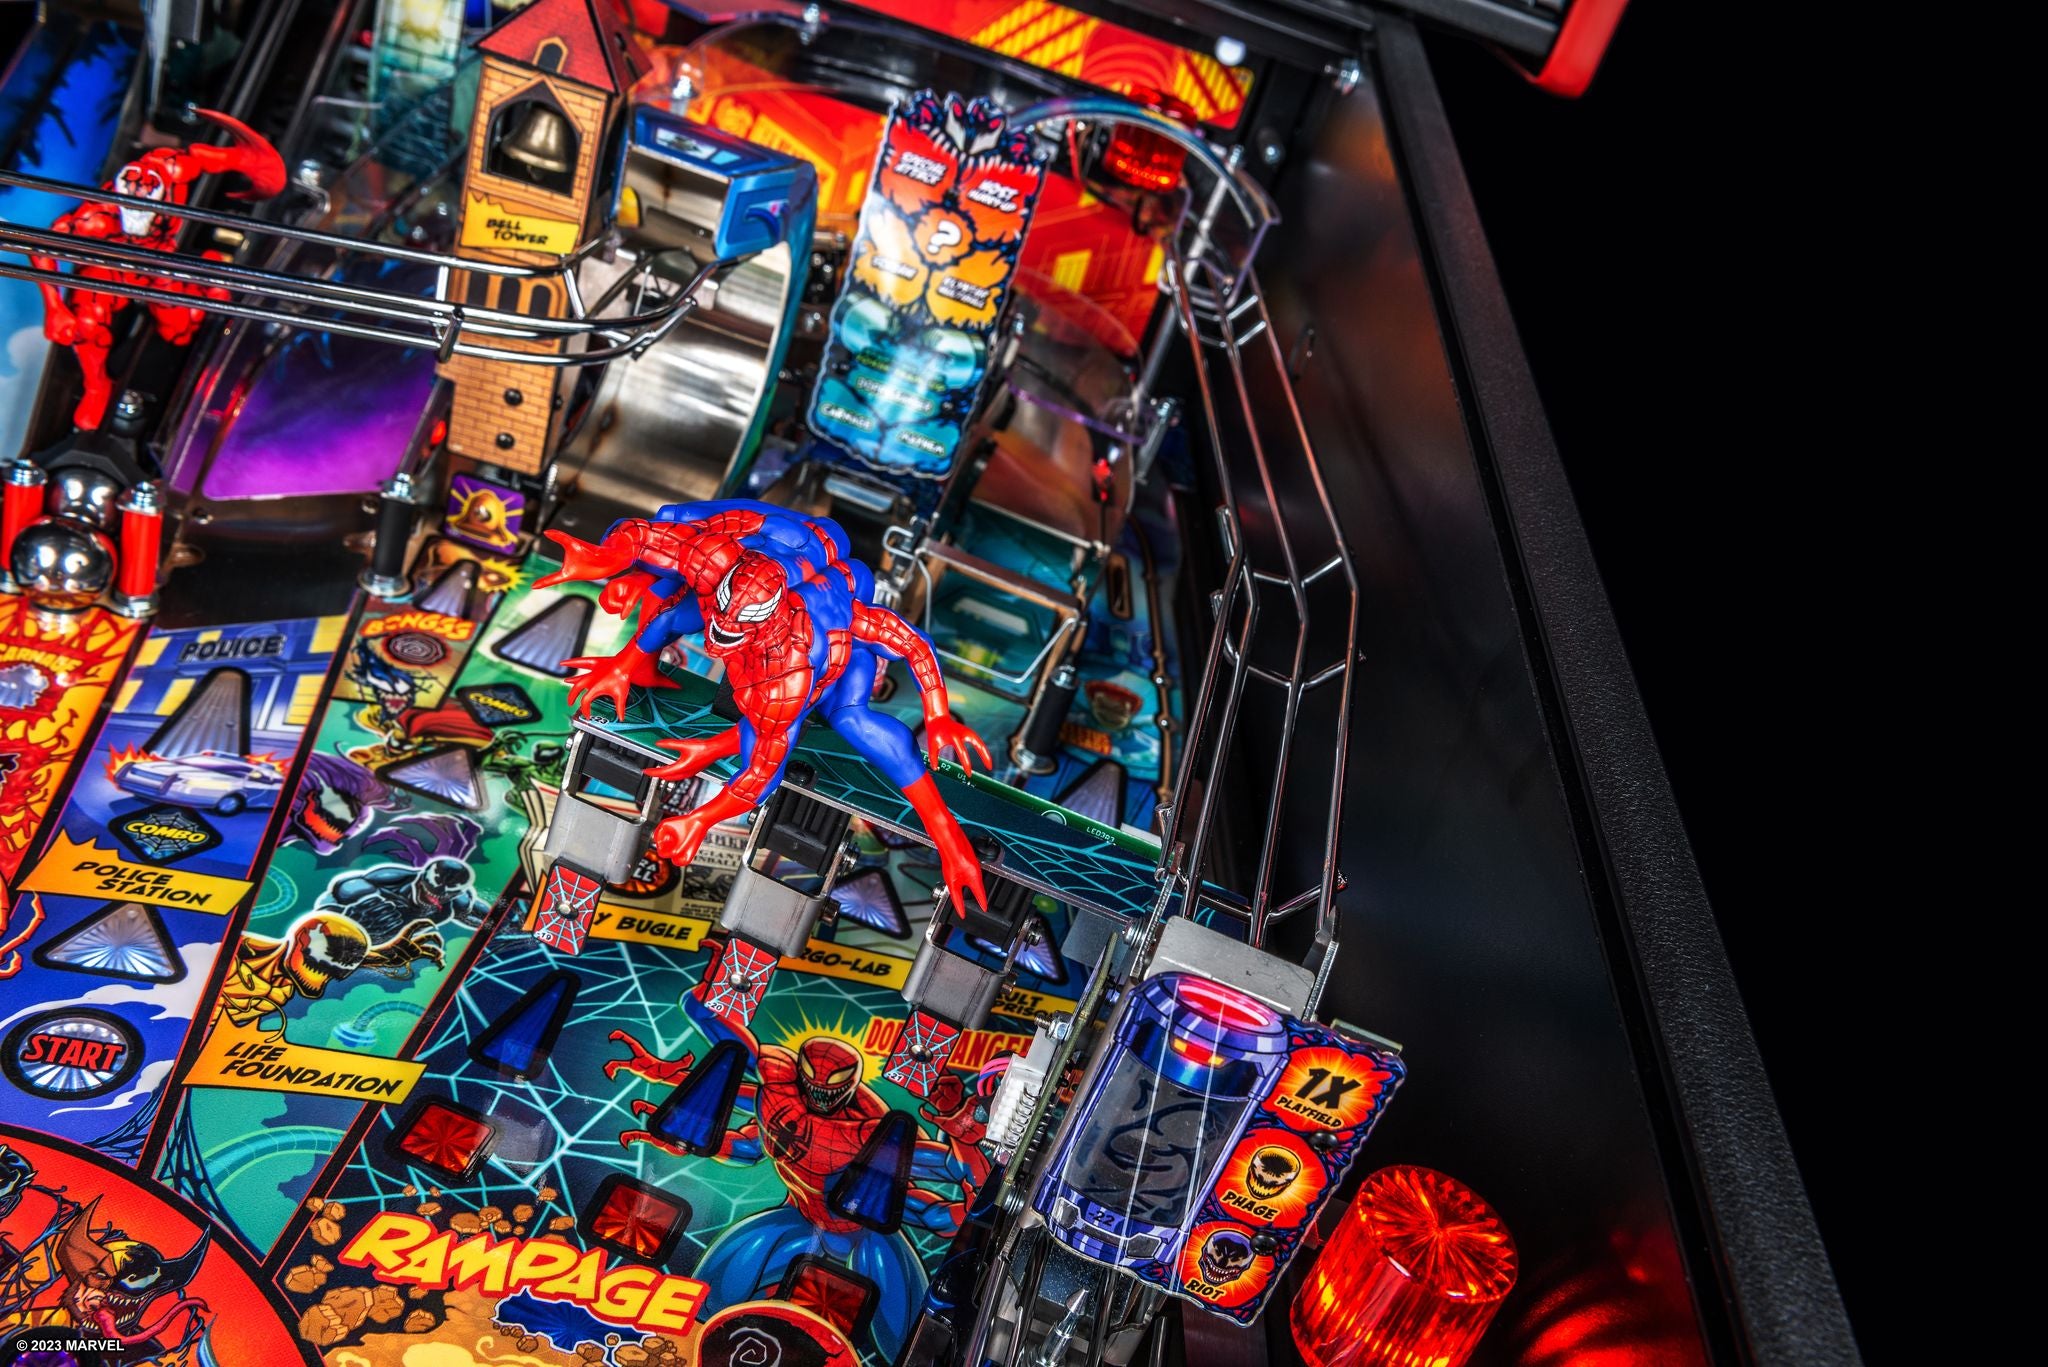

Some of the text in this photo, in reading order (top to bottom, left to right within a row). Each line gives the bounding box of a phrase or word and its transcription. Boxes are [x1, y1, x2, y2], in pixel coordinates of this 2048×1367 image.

[486, 218, 521, 231] BELL
[494, 229, 548, 245] TOWER
[181, 635, 285, 661] POLICE
[127, 822, 206, 843] COMBO
[74, 861, 173, 886] POLICE
[100, 878, 213, 907] STATION
[615, 916, 693, 941] BUGLE
[24, 1034, 126, 1073] START
[223, 1042, 286, 1061] LIFE
[220, 1060, 404, 1097] FOUNDATION
[1294, 1067, 1363, 1110] 1X
[1276, 1095, 1343, 1129] PLAYFIELD
[1222, 1190, 1279, 1221] PHAGE
[1088, 1210, 1116, 1227] -22
[341, 1213, 708, 1332] RAMPAGE
[1186, 1279, 1225, 1301] RIOT
